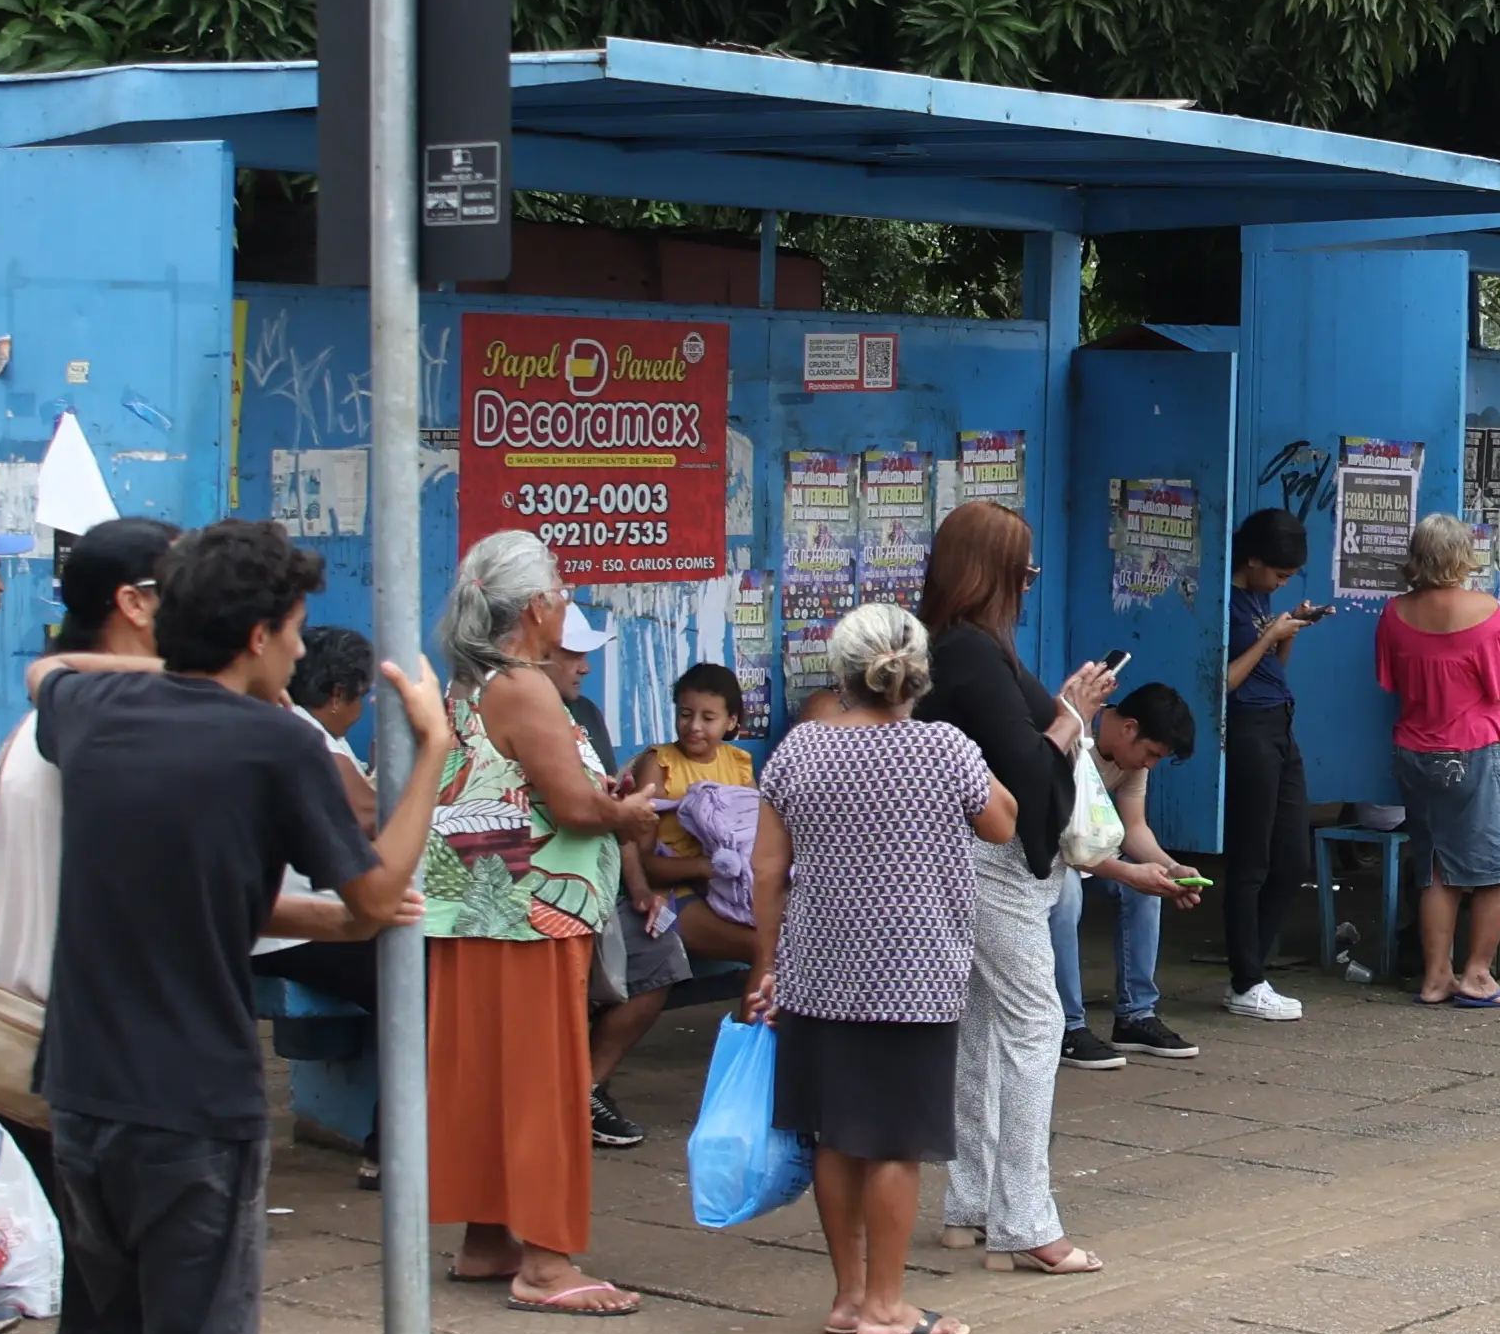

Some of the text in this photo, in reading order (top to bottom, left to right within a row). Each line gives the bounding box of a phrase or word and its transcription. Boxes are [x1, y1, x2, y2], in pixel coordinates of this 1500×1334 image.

[483, 340, 562, 389] Papel
[613, 344, 688, 382] Parede
[808, 361, 831, 369] GRUPO
[474, 389, 702, 448] Decoramax
[518, 483, 669, 515] 3302-0003
[1344, 491, 1409, 510] FORA EUA DA
[1379, 510, 1409, 523] LATINA!
[539, 521, 669, 546] 99210-7535
[1343, 521, 1361, 554] &
[1362, 535, 1387, 546] FRENTE
[564, 560, 593, 573] 2749
[602, 559, 627, 572] ESQ.
[630, 558, 673, 571] CARLOS
[676, 556, 716, 569] GOMES
